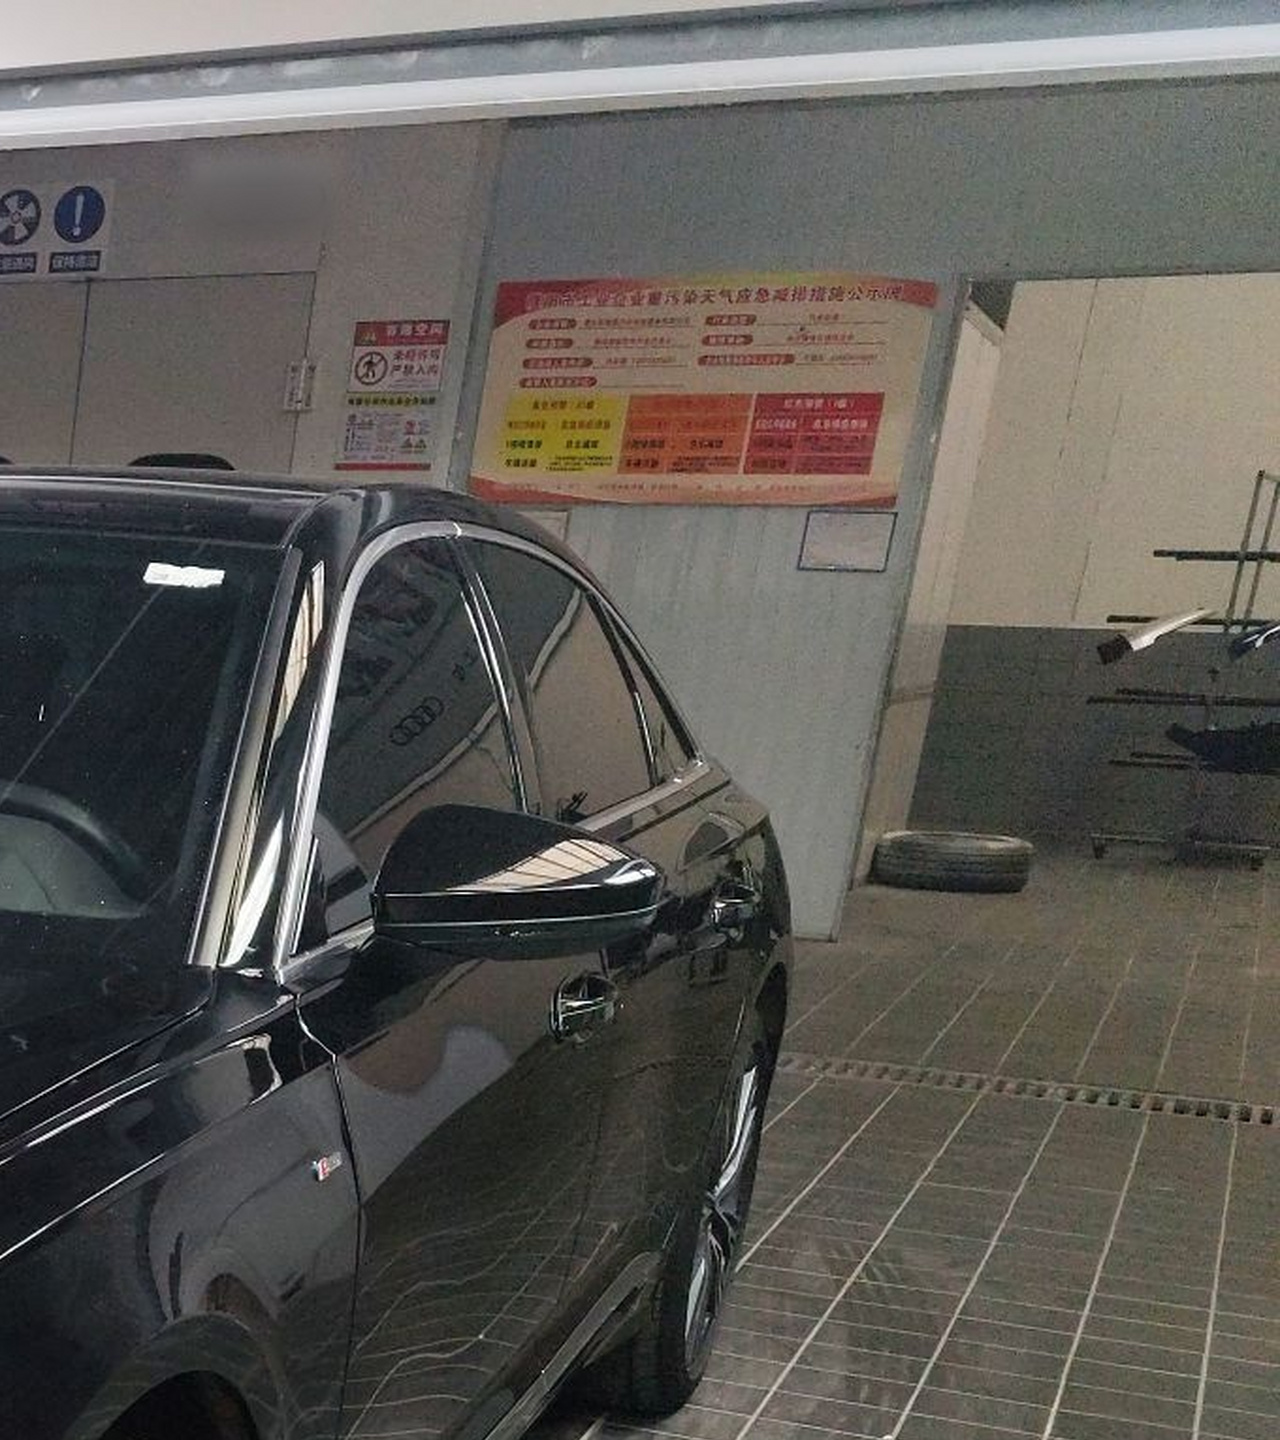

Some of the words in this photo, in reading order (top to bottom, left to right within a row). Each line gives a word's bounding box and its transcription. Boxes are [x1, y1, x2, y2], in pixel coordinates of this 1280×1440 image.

[526, 285, 903, 310] 市工业企业重污染天气应急减排措施公示牌
